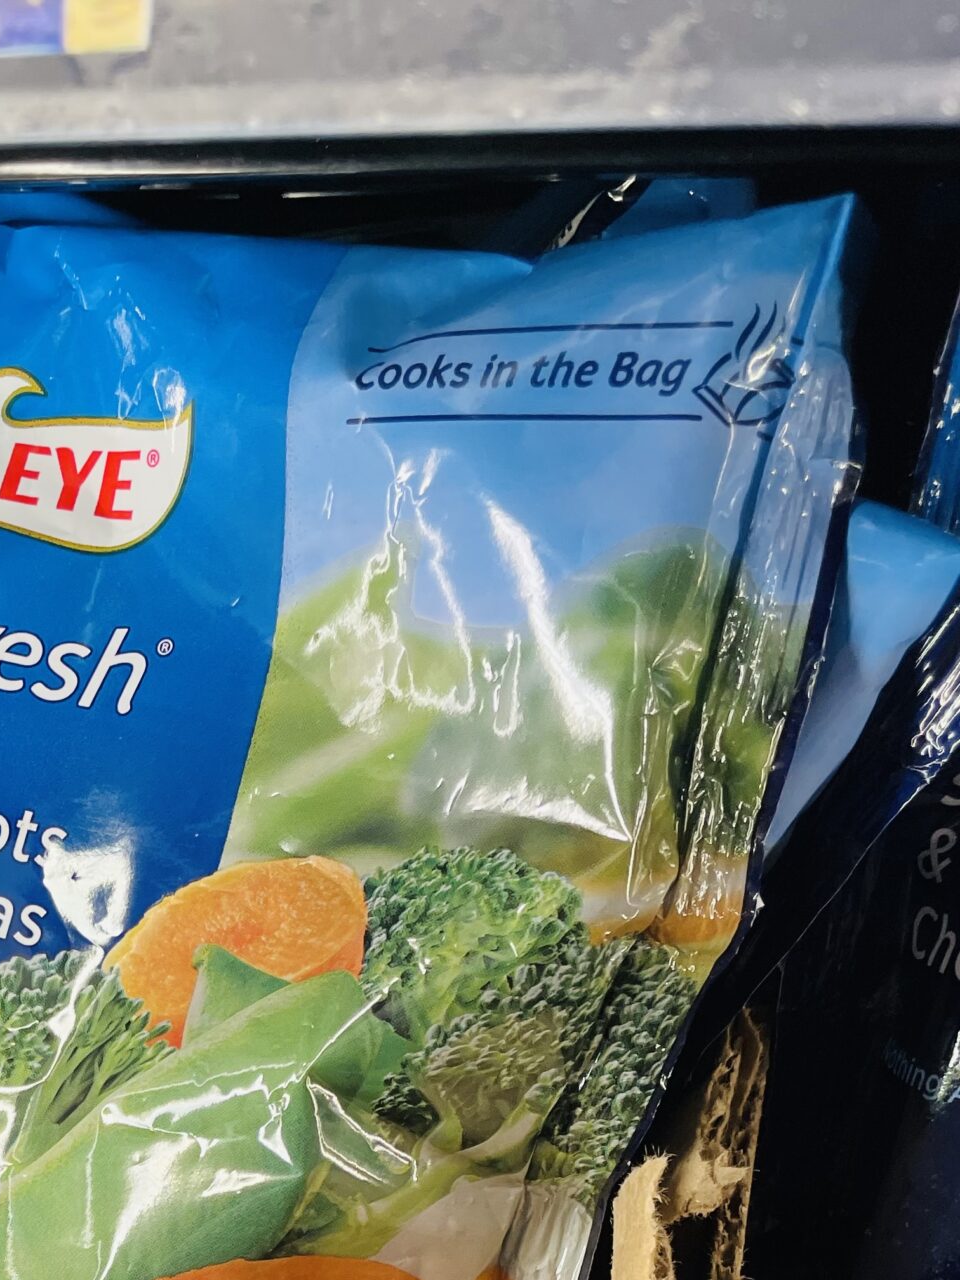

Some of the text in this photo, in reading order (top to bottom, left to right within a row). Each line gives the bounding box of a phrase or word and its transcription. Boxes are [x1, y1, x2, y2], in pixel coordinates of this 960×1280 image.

[355, 351, 691, 397] Cooks in the Bag
